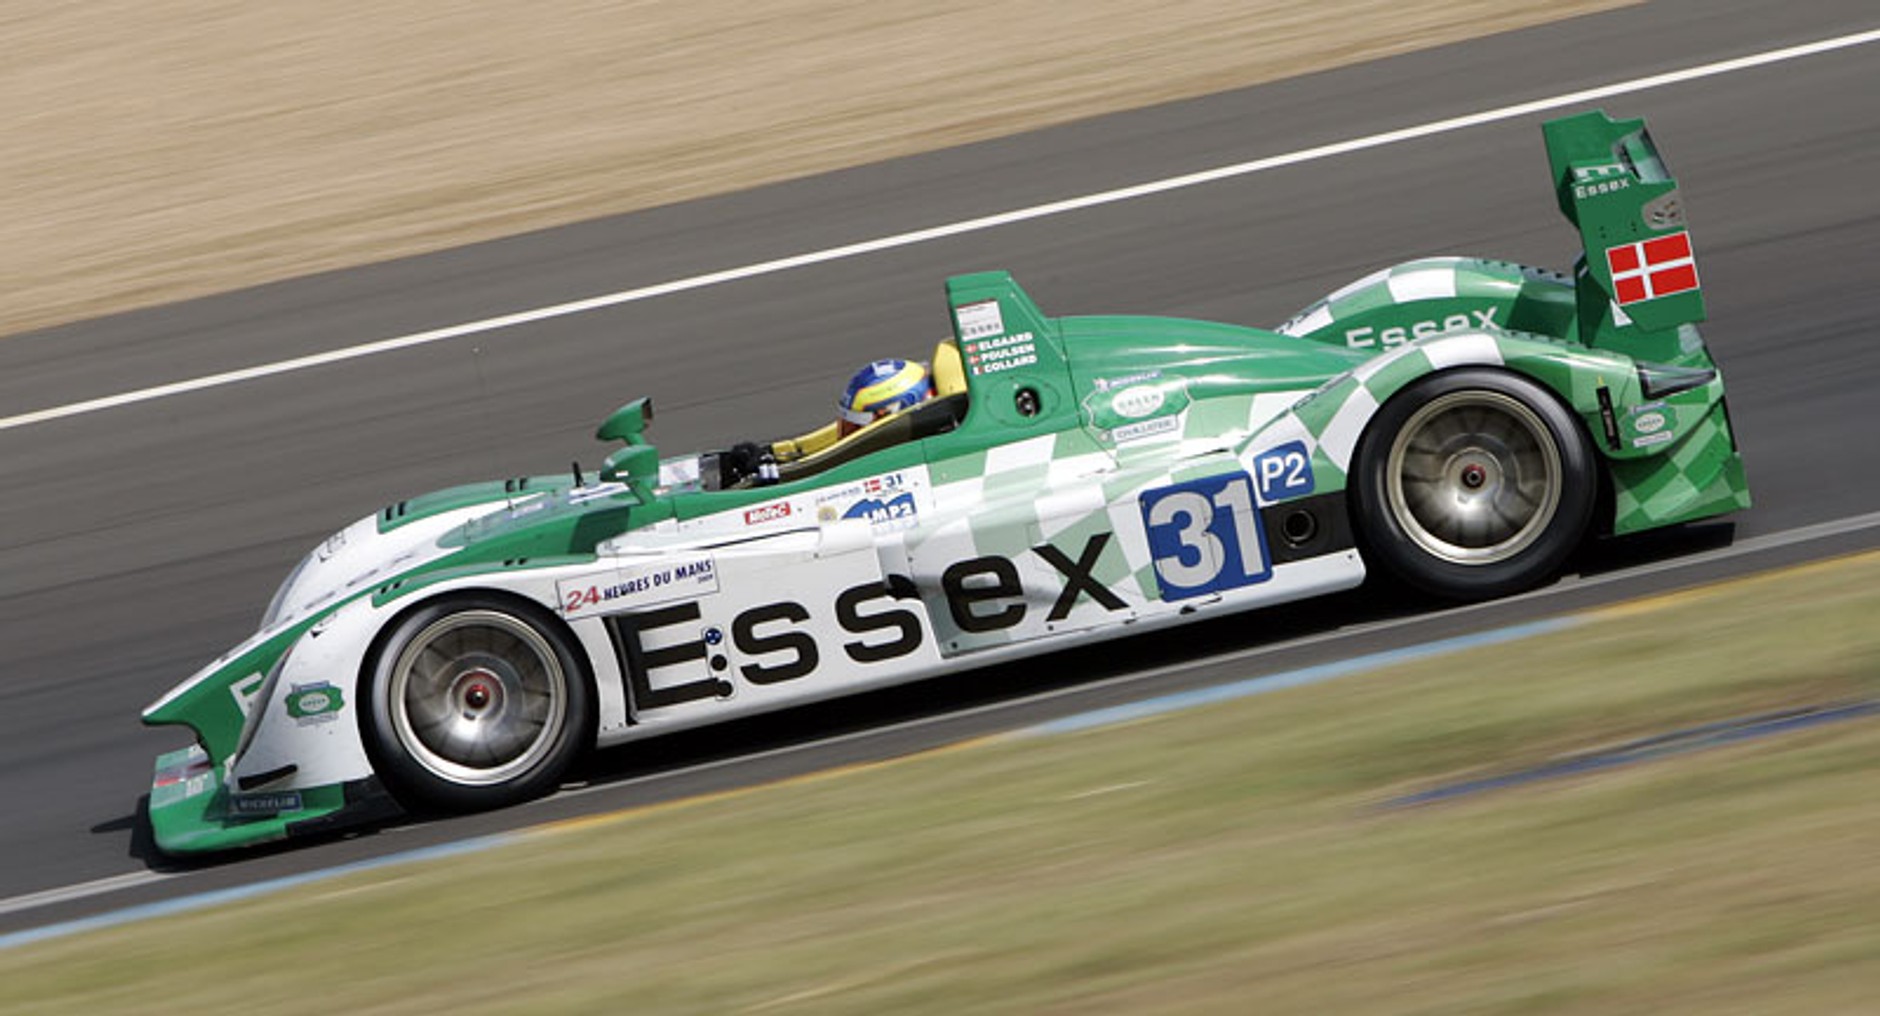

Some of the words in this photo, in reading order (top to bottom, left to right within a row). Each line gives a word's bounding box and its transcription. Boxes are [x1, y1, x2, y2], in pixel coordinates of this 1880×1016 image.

[1575, 178, 1629, 199] Essex
[978, 332, 1034, 351] ELGAARD
[981, 344, 1035, 362] POULSEN
[984, 355, 1037, 373] COLLARD
[885, 474, 903, 488] 31
[1261, 452, 1306, 493] P2
[1149, 479, 1266, 588] 31
[566, 586, 600, 612] 24
[603, 577, 650, 600] HEURES
[653, 571, 671, 587] DU
[675, 560, 711, 581] MANS
[615, 532, 1131, 712] Essex
